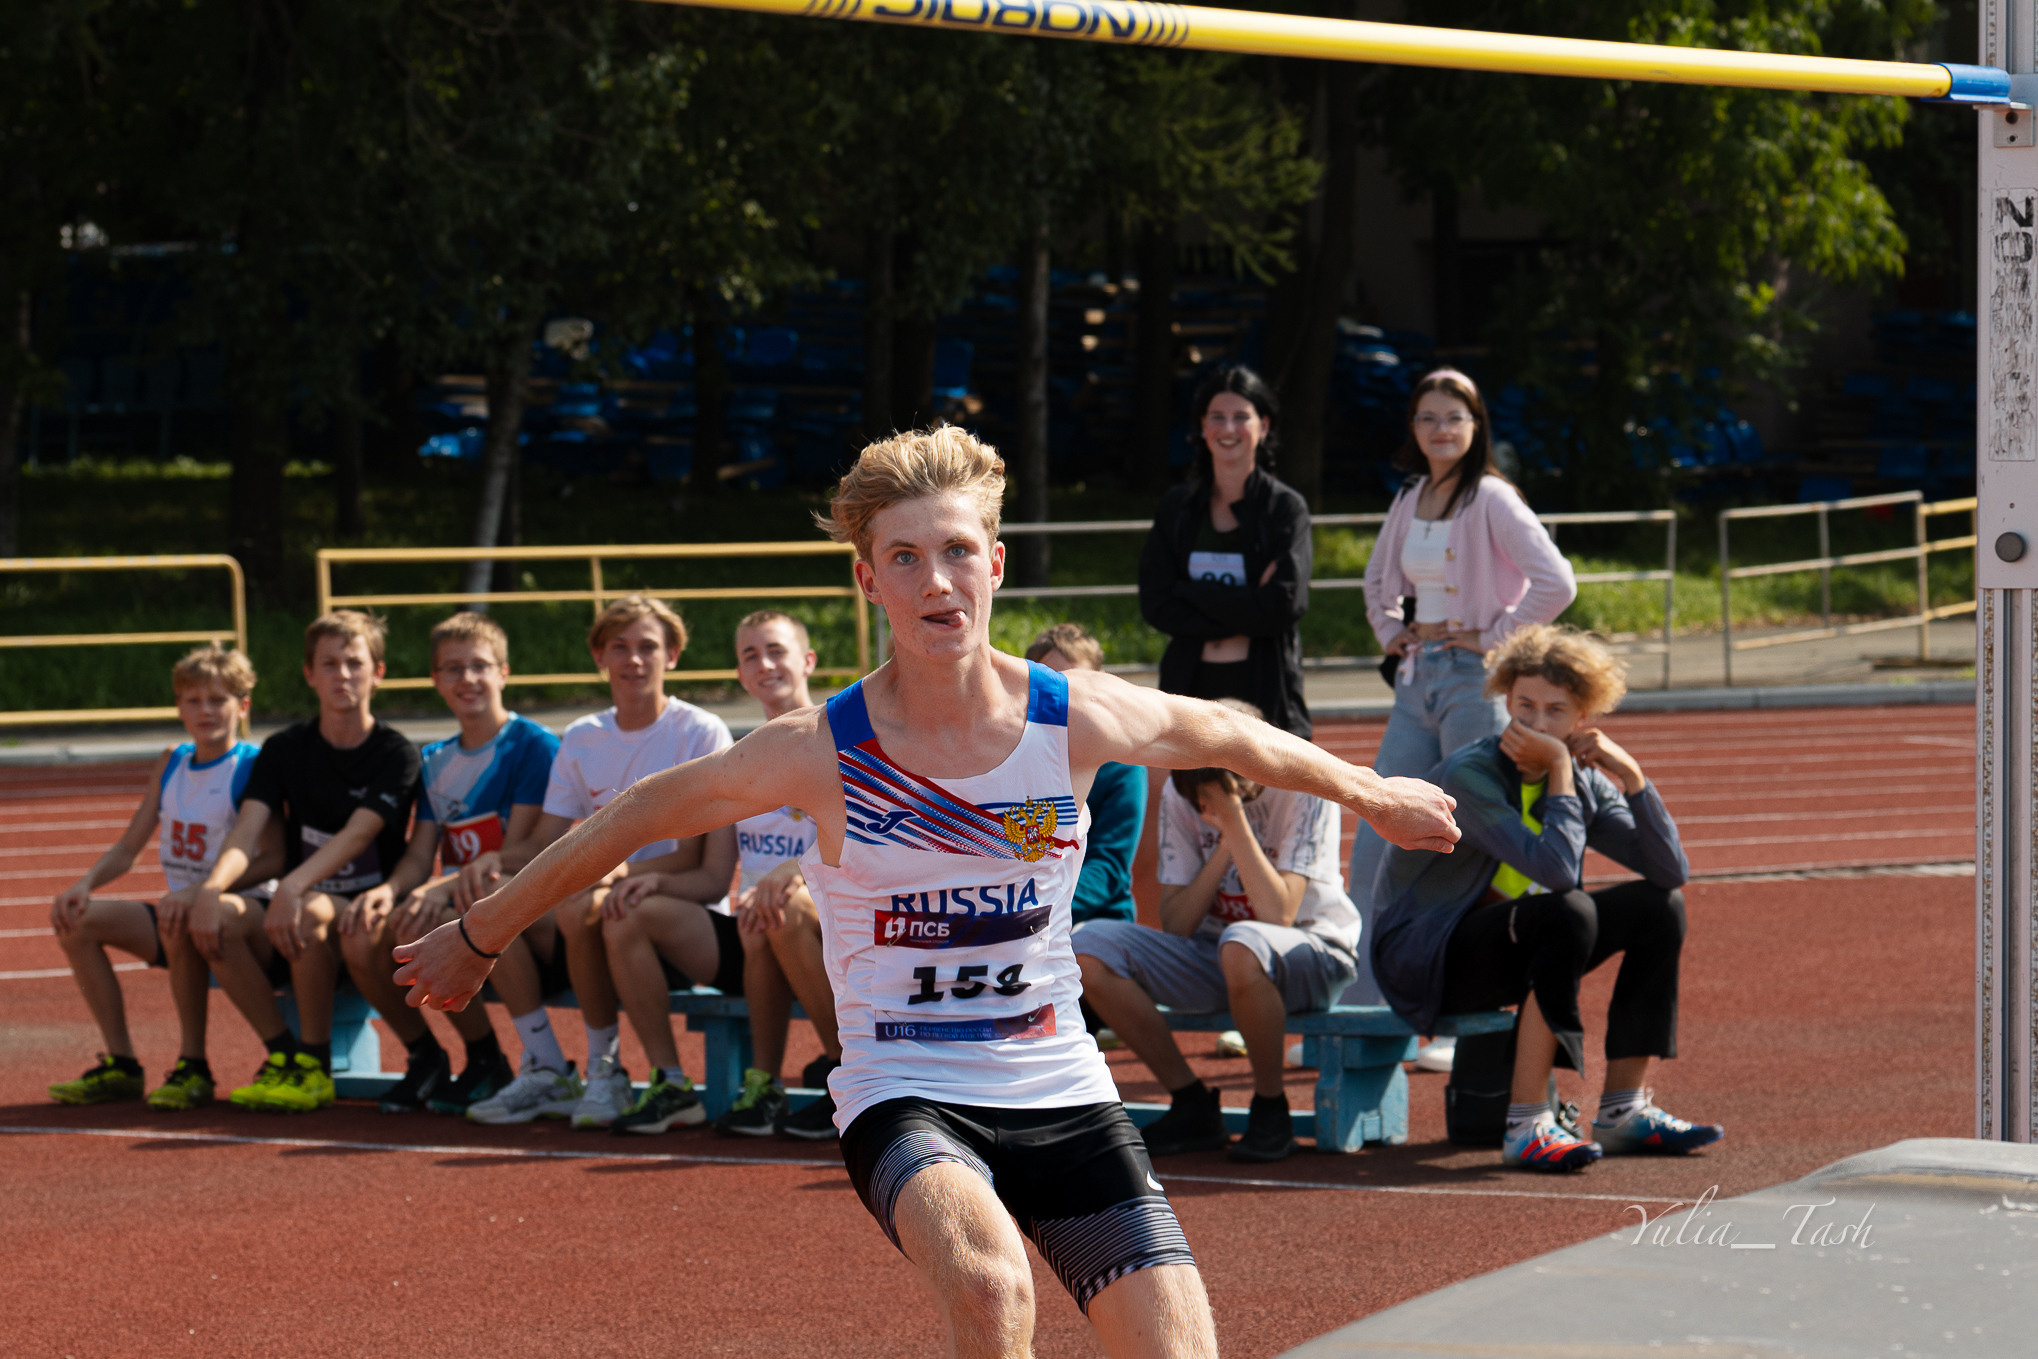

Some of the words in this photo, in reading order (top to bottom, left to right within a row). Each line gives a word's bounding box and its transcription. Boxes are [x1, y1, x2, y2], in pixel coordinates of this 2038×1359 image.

[171, 820, 207, 861] 55
[739, 832, 804, 857] RUSSIA
[891, 878, 1039, 916] RUSSIA
[909, 921, 950, 937] ПСБ
[885, 1024, 916, 1038] U16
